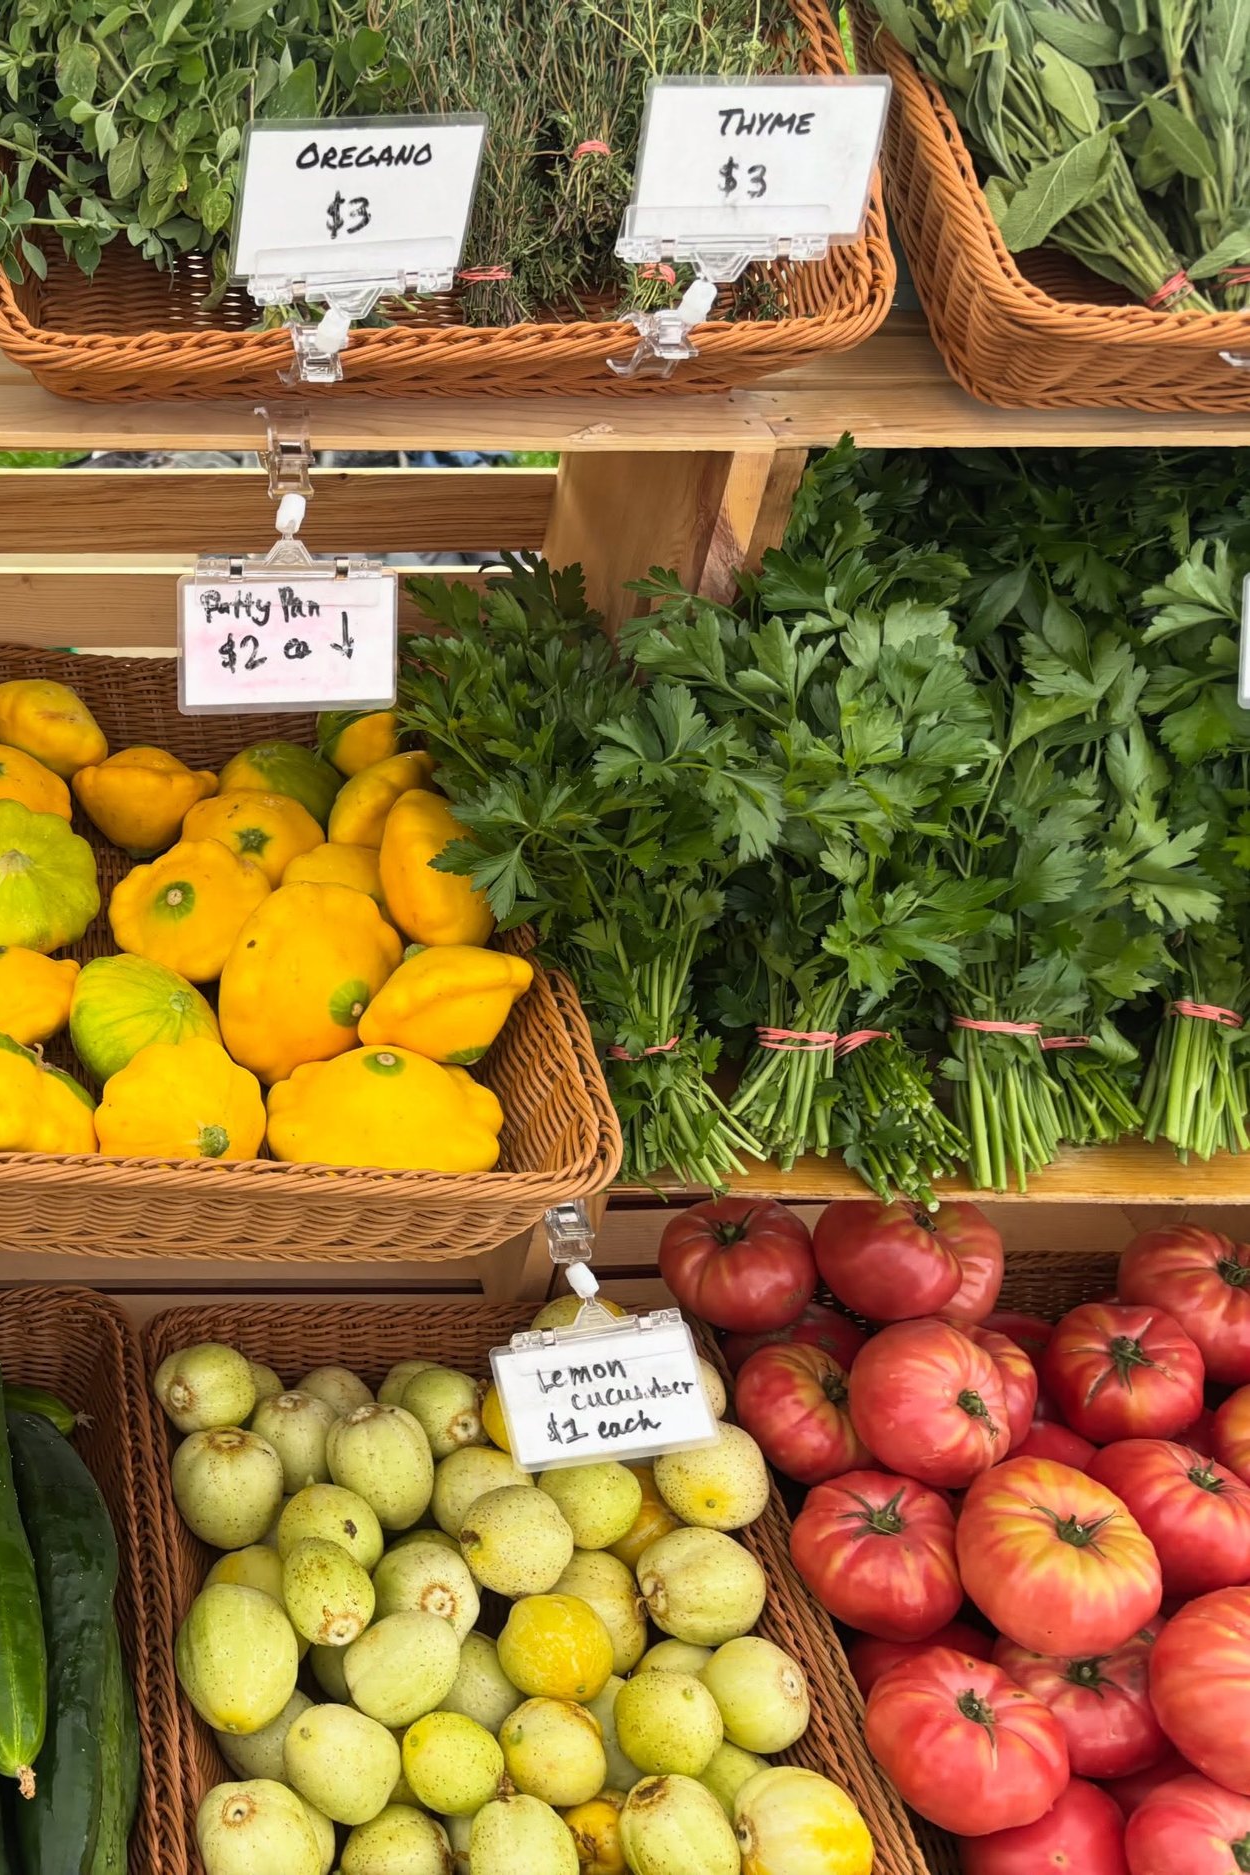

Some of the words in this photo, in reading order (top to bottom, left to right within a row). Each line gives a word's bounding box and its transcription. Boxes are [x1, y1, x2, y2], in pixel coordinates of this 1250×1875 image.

[719, 108, 815, 136] THYME
[296, 142, 433, 170] OREGANO
[718, 156, 767, 198] $3
[326, 190, 371, 239] $3
[200, 589, 271, 626] Patty
[278, 586, 321, 623] Pan
[218, 632, 268, 674] $2
[537, 1359, 627, 1394] Lemon
[547, 1413, 588, 1444] $1
[598, 1410, 661, 1440] each
